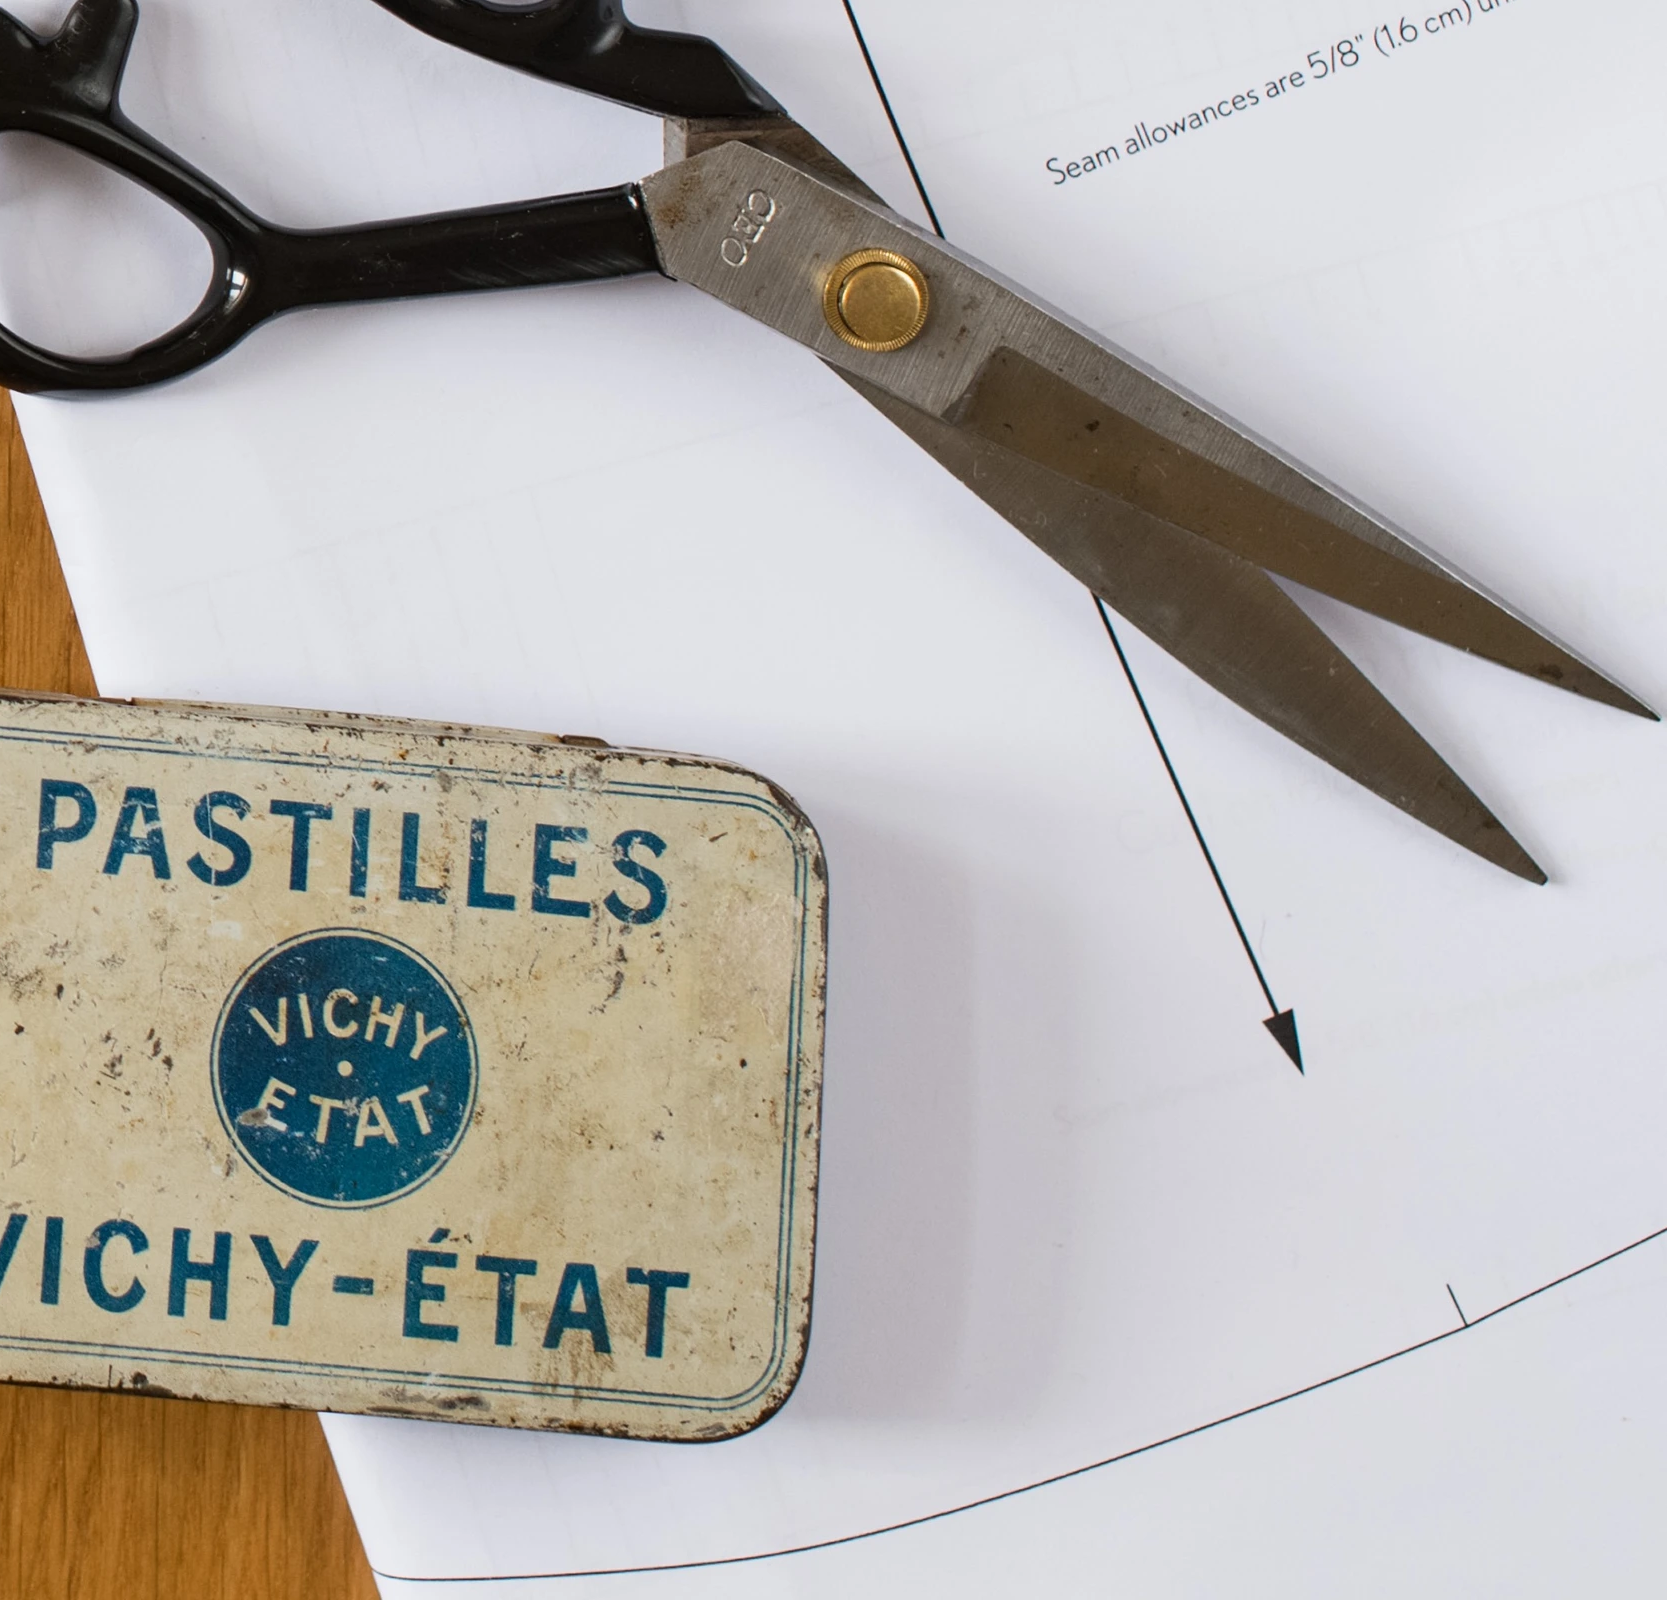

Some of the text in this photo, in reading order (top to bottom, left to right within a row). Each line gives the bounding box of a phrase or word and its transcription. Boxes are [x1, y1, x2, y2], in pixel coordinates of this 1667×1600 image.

[1046, 146, 1120, 185] Seam
[1125, 89, 1259, 155] allowances
[1265, 72, 1305, 98] are
[1307, 34, 1363, 79] 5/8"
[1373, 17, 1419, 57] (1.6
[721, 189, 776, 267] CEO
[37, 779, 669, 925] PASTILLES
[248, 988, 449, 1061] VICHY
